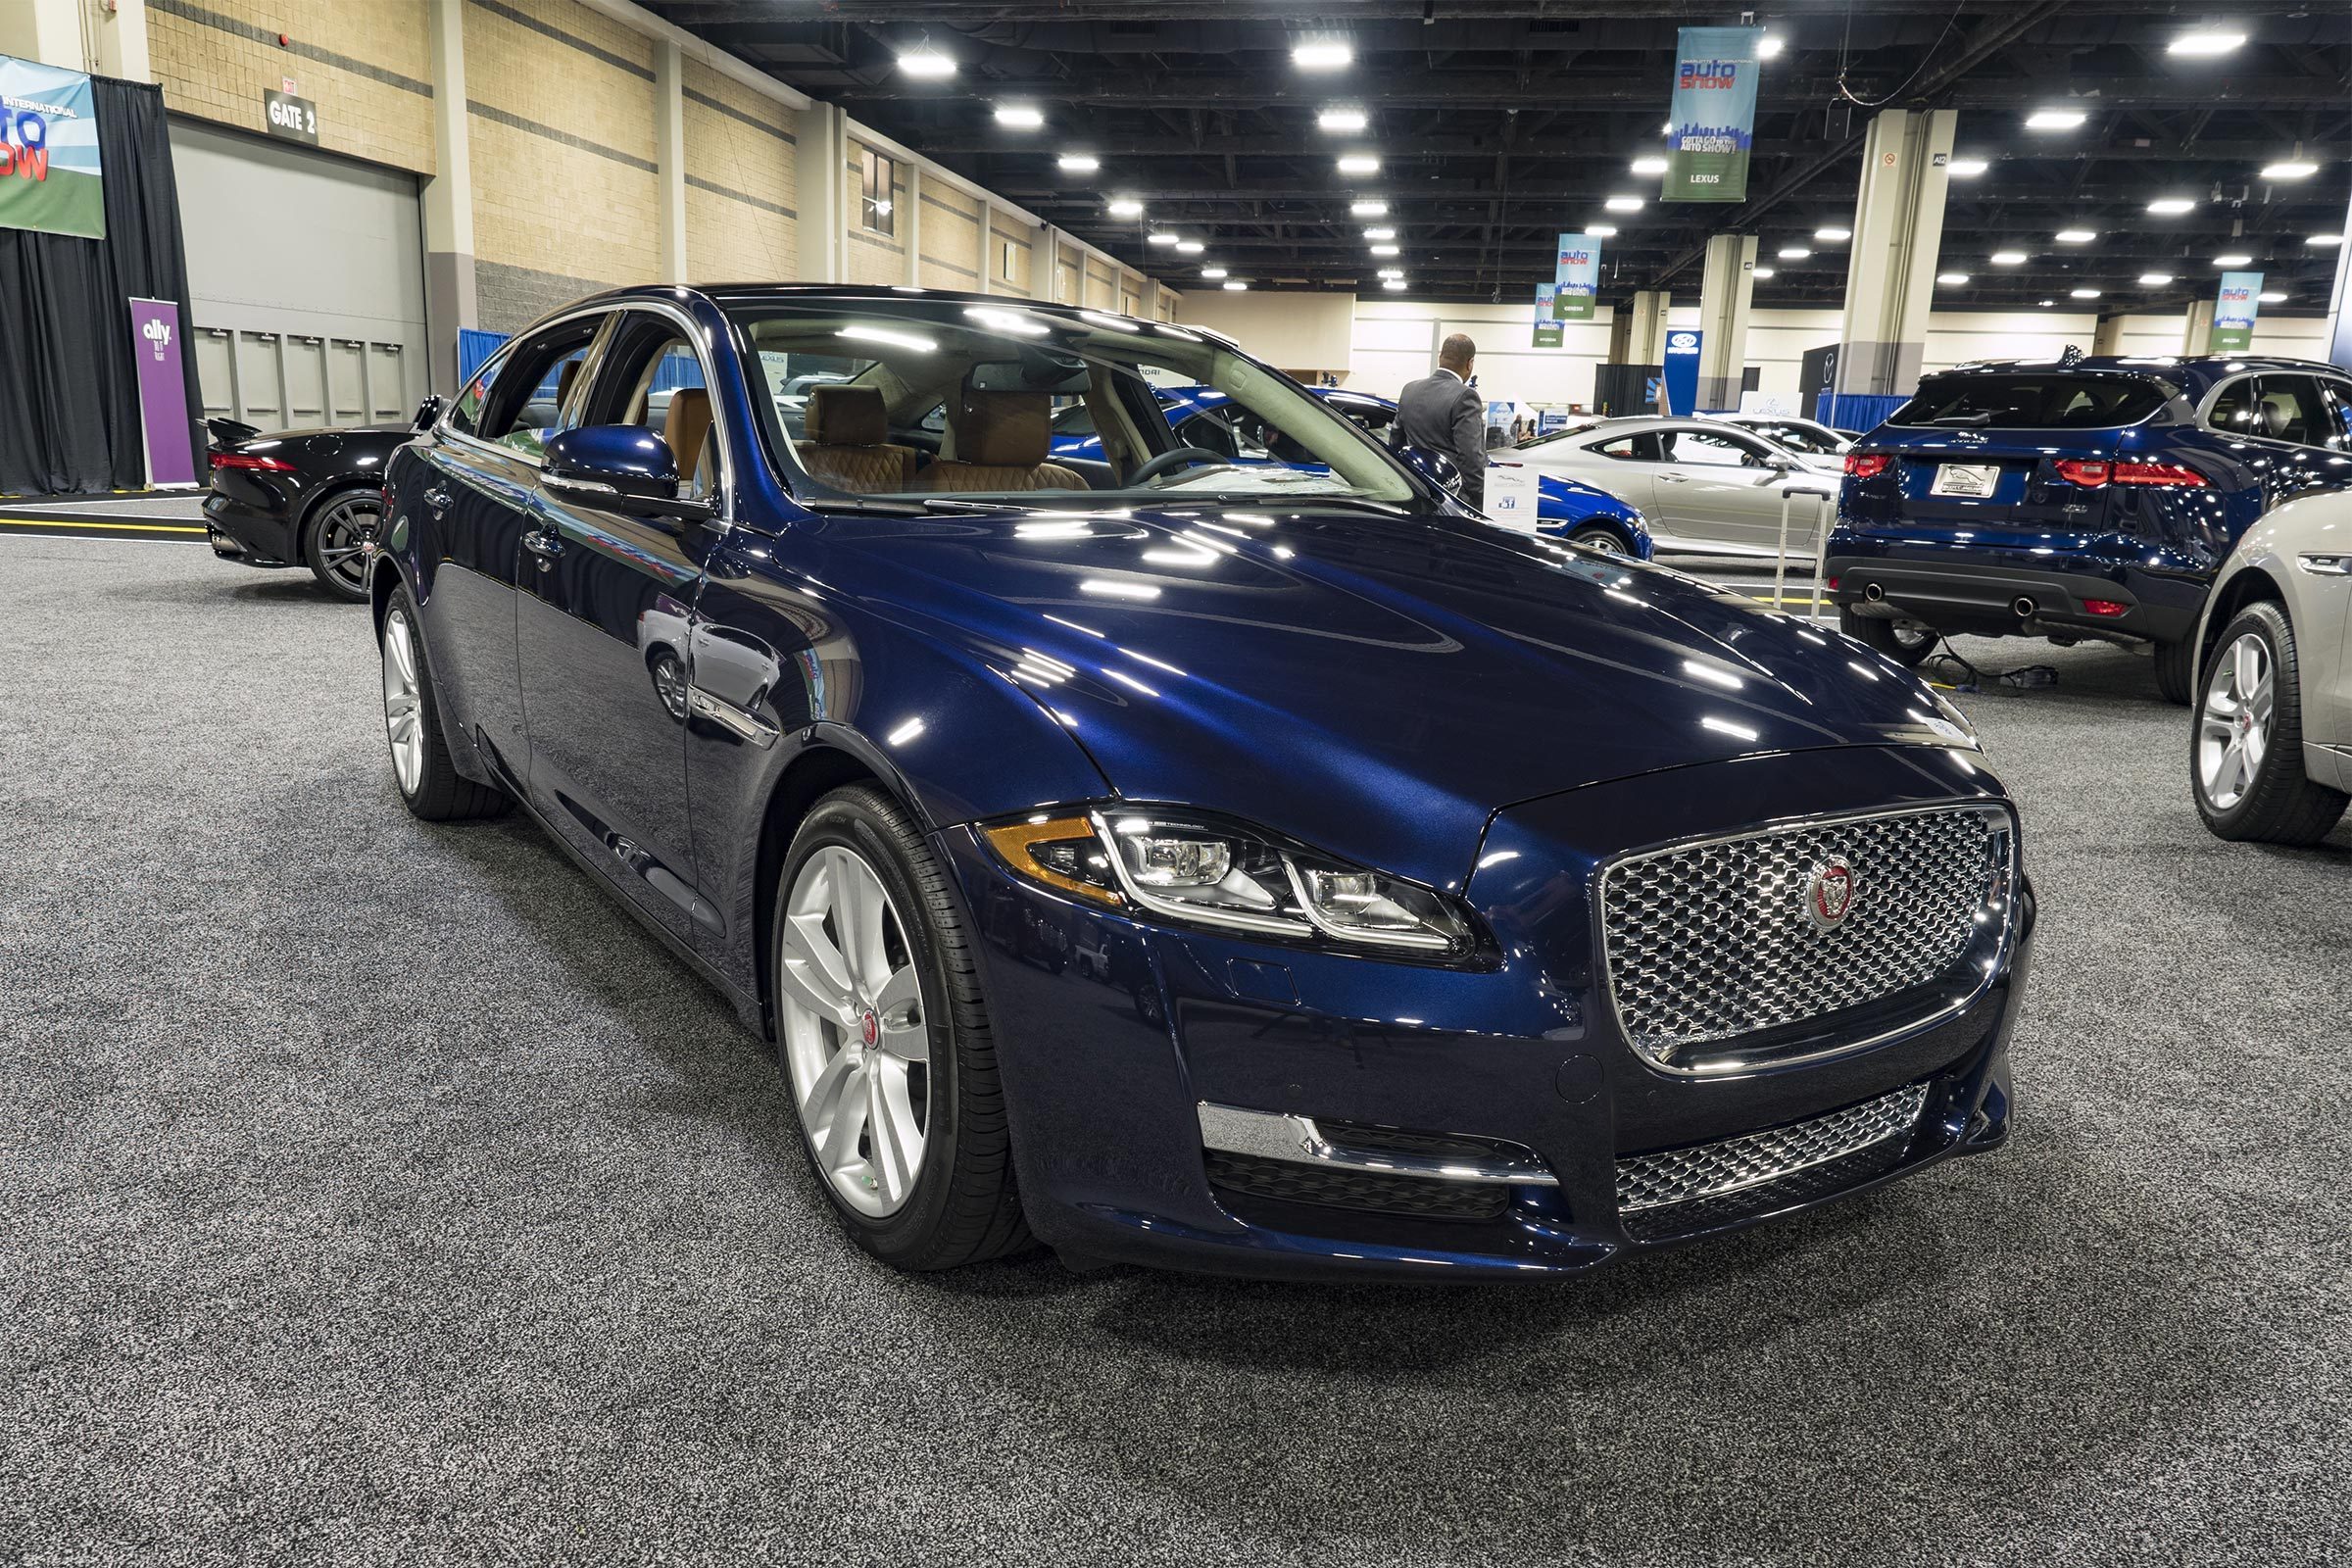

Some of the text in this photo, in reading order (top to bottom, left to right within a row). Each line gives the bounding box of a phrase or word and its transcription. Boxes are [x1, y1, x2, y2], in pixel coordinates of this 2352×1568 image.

[1680, 60, 1737, 77] auto
[1680, 74, 1737, 89] show
[3, 96, 78, 119] INTERNATIONAL
[0, 95, 47, 151] to
[270, 100, 316, 134] GATE 2
[1682, 135, 1703, 145] GOTTA
[1704, 135, 1717, 145] GO
[1680, 143, 1738, 155] AUTO SHOW!
[1690, 173, 1720, 183] LEXUS
[1560, 250, 1589, 260] auto
[2222, 287, 2250, 296] auto
